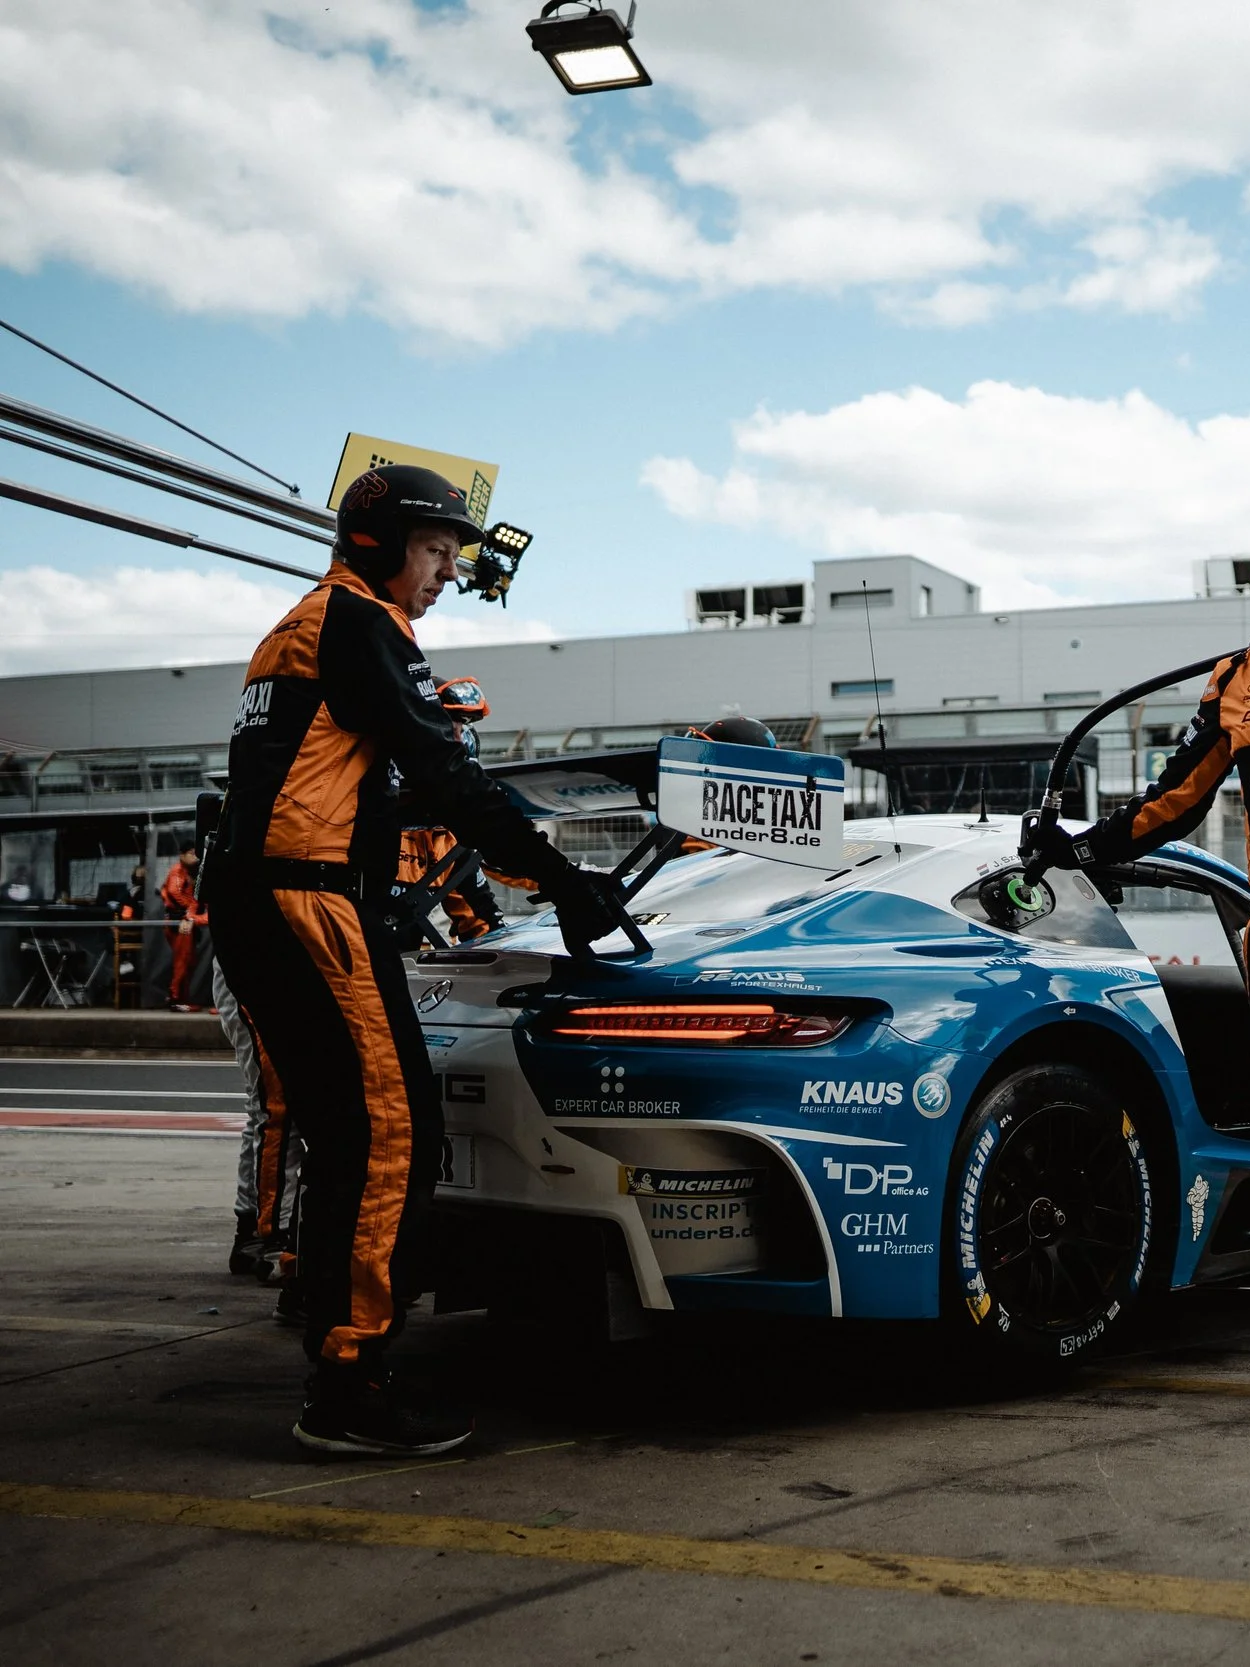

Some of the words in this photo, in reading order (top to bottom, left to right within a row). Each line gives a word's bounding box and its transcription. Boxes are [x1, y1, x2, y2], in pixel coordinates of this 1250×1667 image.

[702, 780, 822, 831] RACETAXI
[701, 827, 821, 847] under8.de
[692, 970, 805, 983] REMUS
[730, 981, 822, 992] SPORTEXHAUST
[800, 1080, 904, 1106] KNAUS
[555, 1099, 597, 1112] EXPERT
[600, 1100, 625, 1113] CAR
[628, 1101, 680, 1115] BROKER
[658, 1177, 754, 1192] MICHELIN
[891, 1187, 914, 1196] office
[916, 1187, 929, 1196] AG
[960, 1129, 995, 1269] MICHELIN
[840, 1213, 909, 1237] GHM
[1134, 1158, 1152, 1285] MICHELIN
[883, 1241, 934, 1255] Partners
